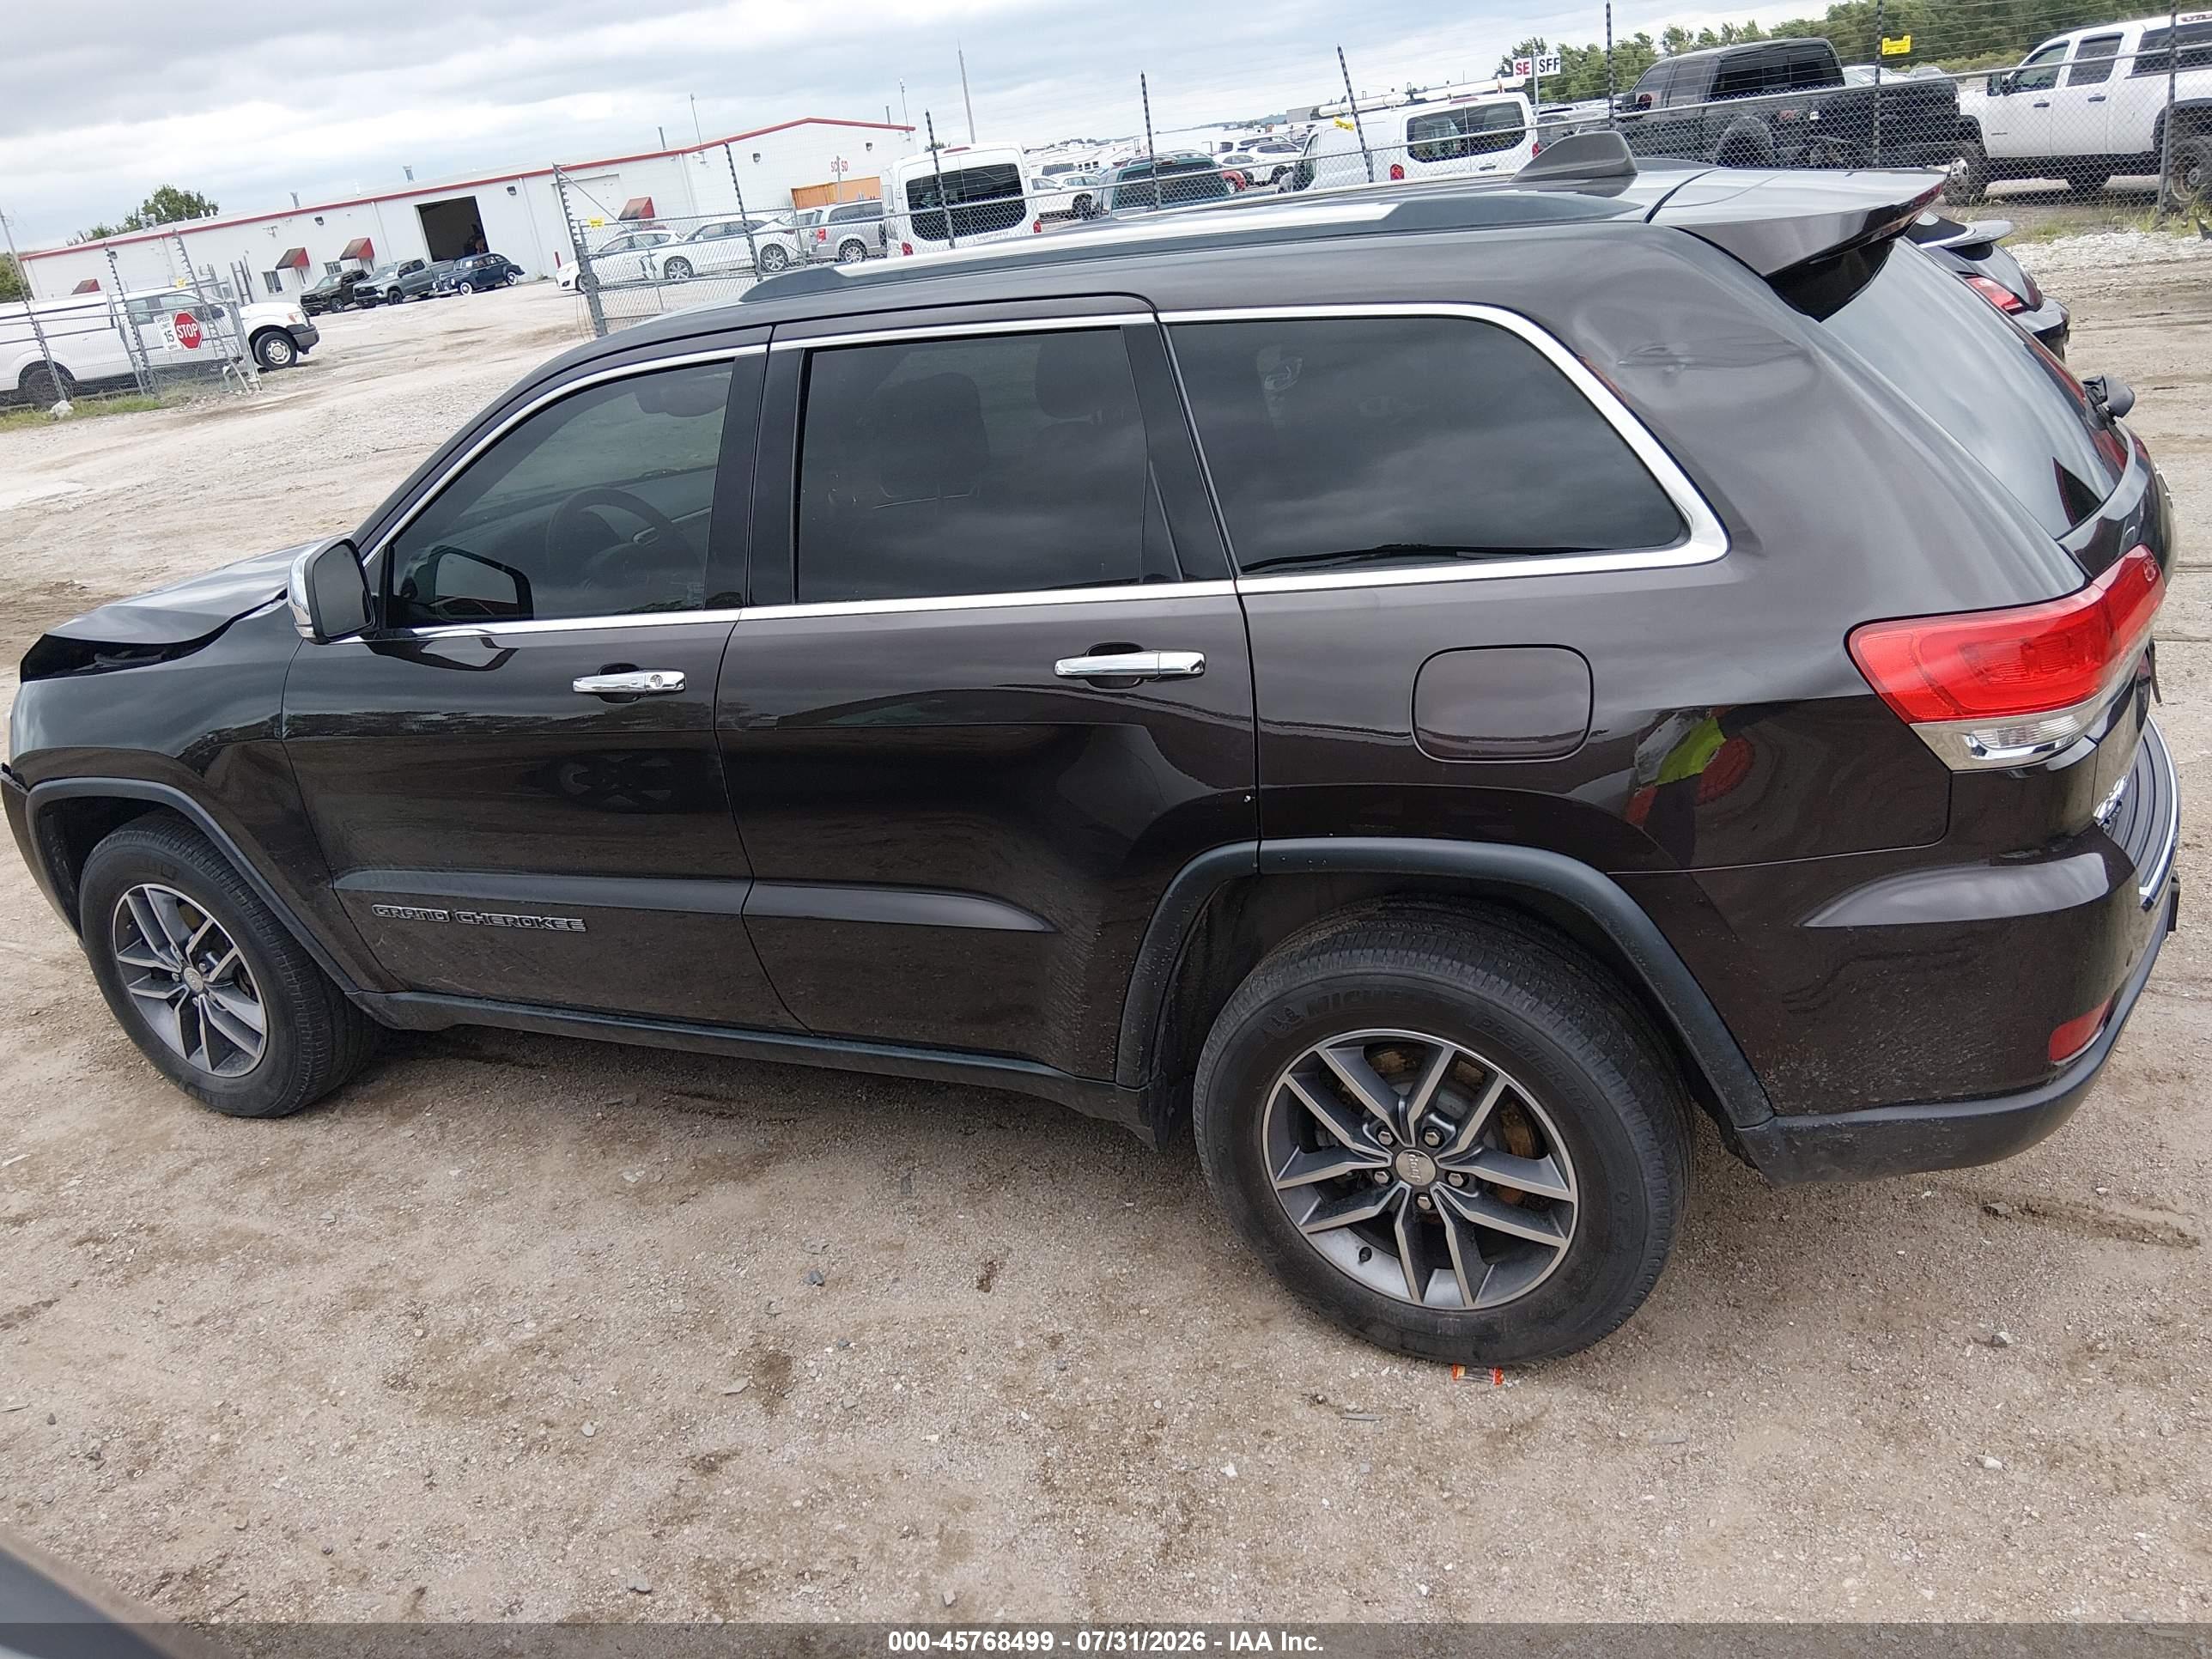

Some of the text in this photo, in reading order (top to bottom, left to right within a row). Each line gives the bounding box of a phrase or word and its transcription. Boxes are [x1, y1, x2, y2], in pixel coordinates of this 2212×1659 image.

[1515, 61, 1530, 76] SE
[1539, 58, 1560, 73] SFF
[164, 330, 175, 343] 15
[176, 323, 198, 339] STOP
[372, 904, 587, 933] GRAND CHEROKEE
